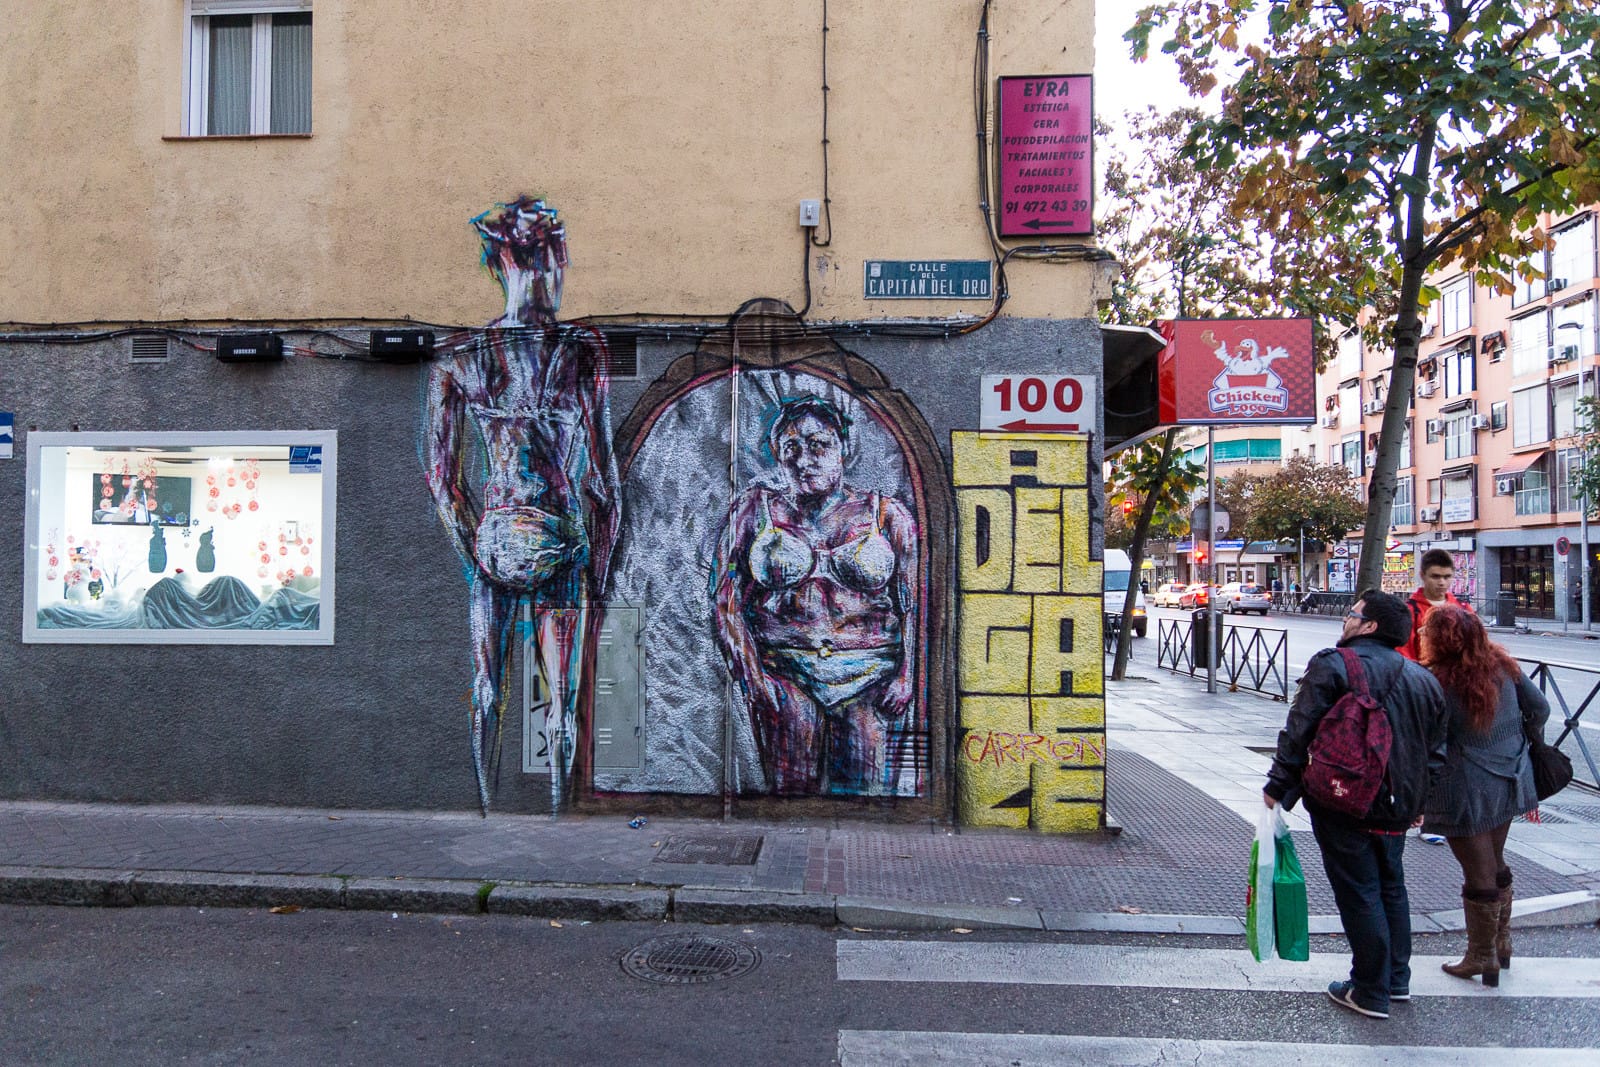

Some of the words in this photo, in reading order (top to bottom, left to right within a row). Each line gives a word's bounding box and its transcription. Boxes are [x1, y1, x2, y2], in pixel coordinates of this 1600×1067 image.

[1023, 81, 1069, 97] EYRA
[1023, 101, 1069, 112] ESTÉTICA
[1033, 119, 1059, 128] CERA
[1004, 133, 1088, 145] FOTODEPILACIÓN
[1007, 151, 1085, 161] TRATAMIENTOS
[1019, 167, 1065, 177] FACIALES
[1067, 167, 1073, 176] Y
[1014, 184, 1078, 193] CORPORALES
[1006, 201, 1018, 213] 91
[1023, 201, 1047, 212] 472
[1051, 200, 1067, 212] 43
[1072, 200, 1087, 211] 39
[910, 263, 947, 272] CALLE
[931, 279, 955, 295] DEL
[962, 279, 987, 295] ORO
[993, 378, 1081, 412] 100
[1215, 390, 1281, 404] Chicken
[1229, 403, 1267, 413] Loco
